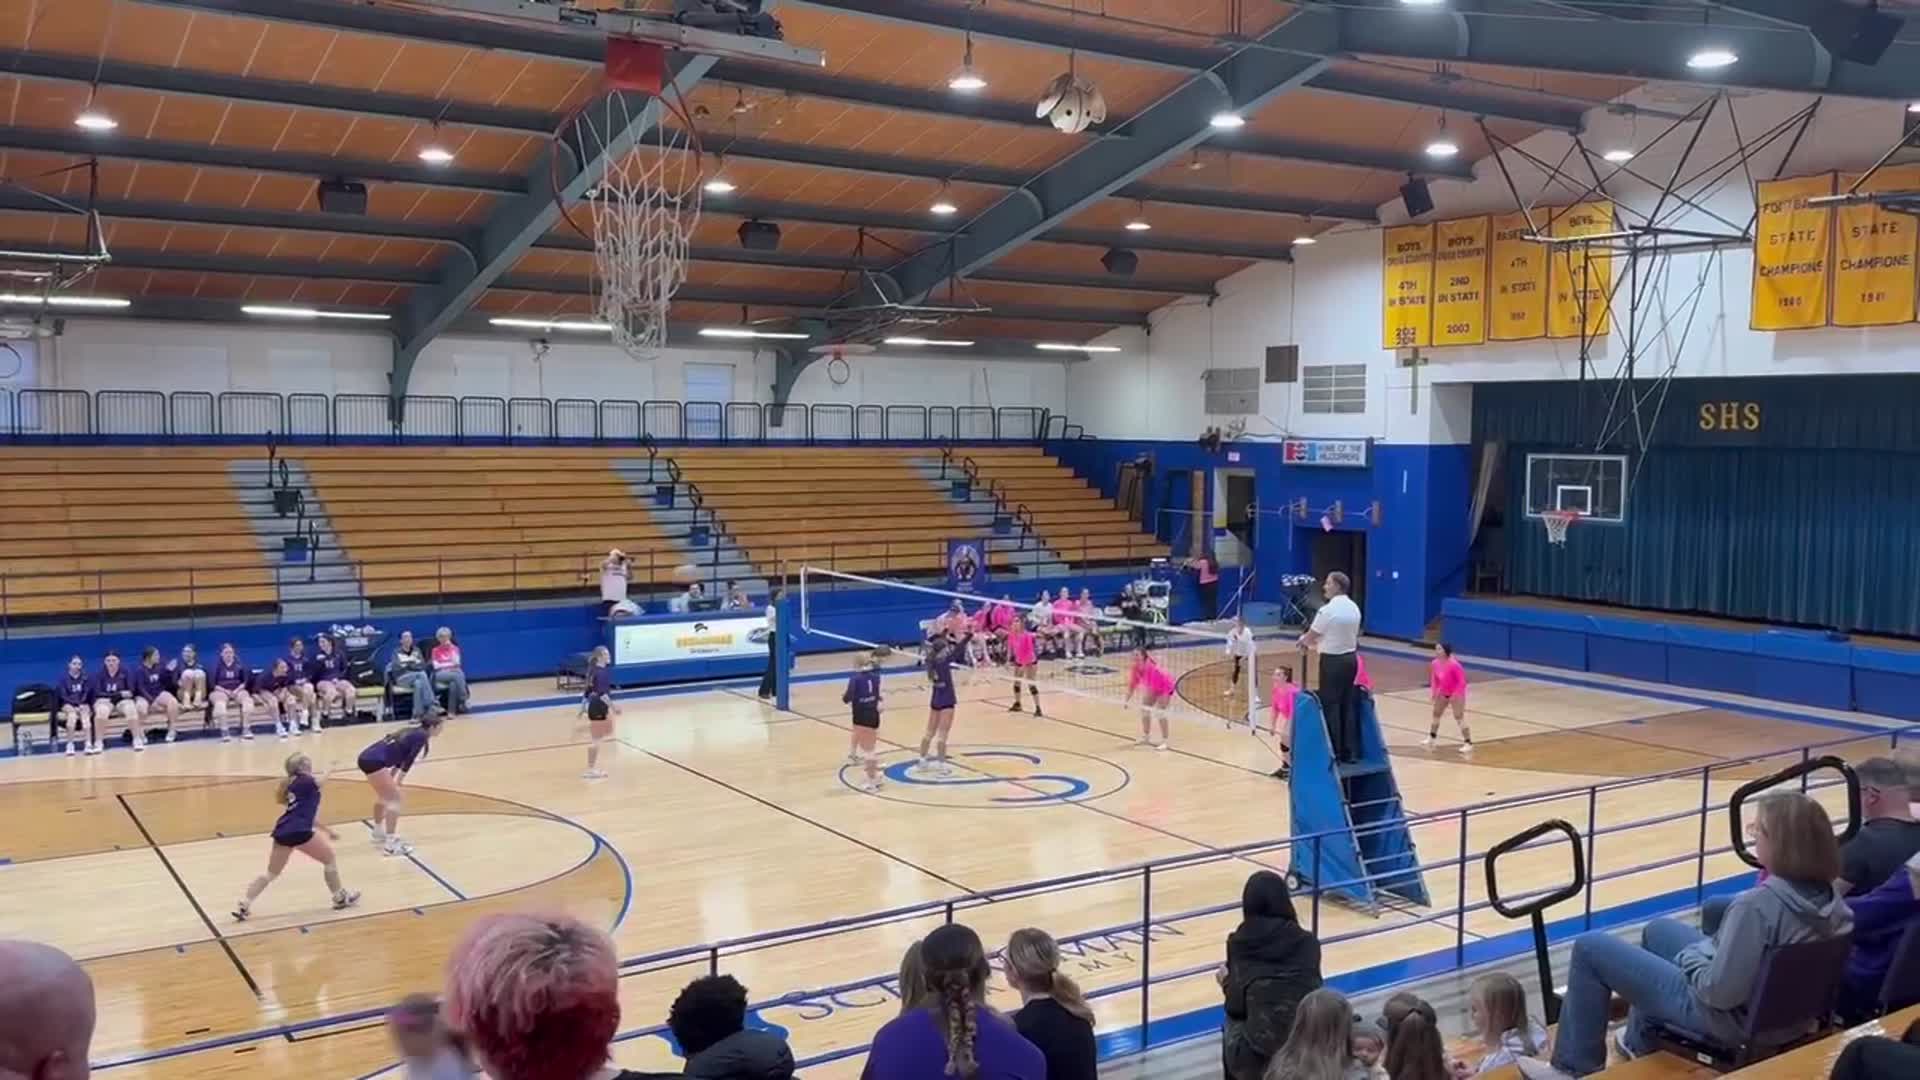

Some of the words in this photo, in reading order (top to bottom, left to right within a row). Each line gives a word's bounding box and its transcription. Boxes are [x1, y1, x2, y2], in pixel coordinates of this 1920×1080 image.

[1770, 230, 1816, 245] STATE
[1852, 222, 1898, 238] STATE
[1447, 237, 1473, 247] BOYS
[1399, 280, 1417, 290] 4TH
[1450, 275, 1470, 286] 2ND
[1699, 402, 1760, 431] SHS
[867, 678, 873, 694] 1
